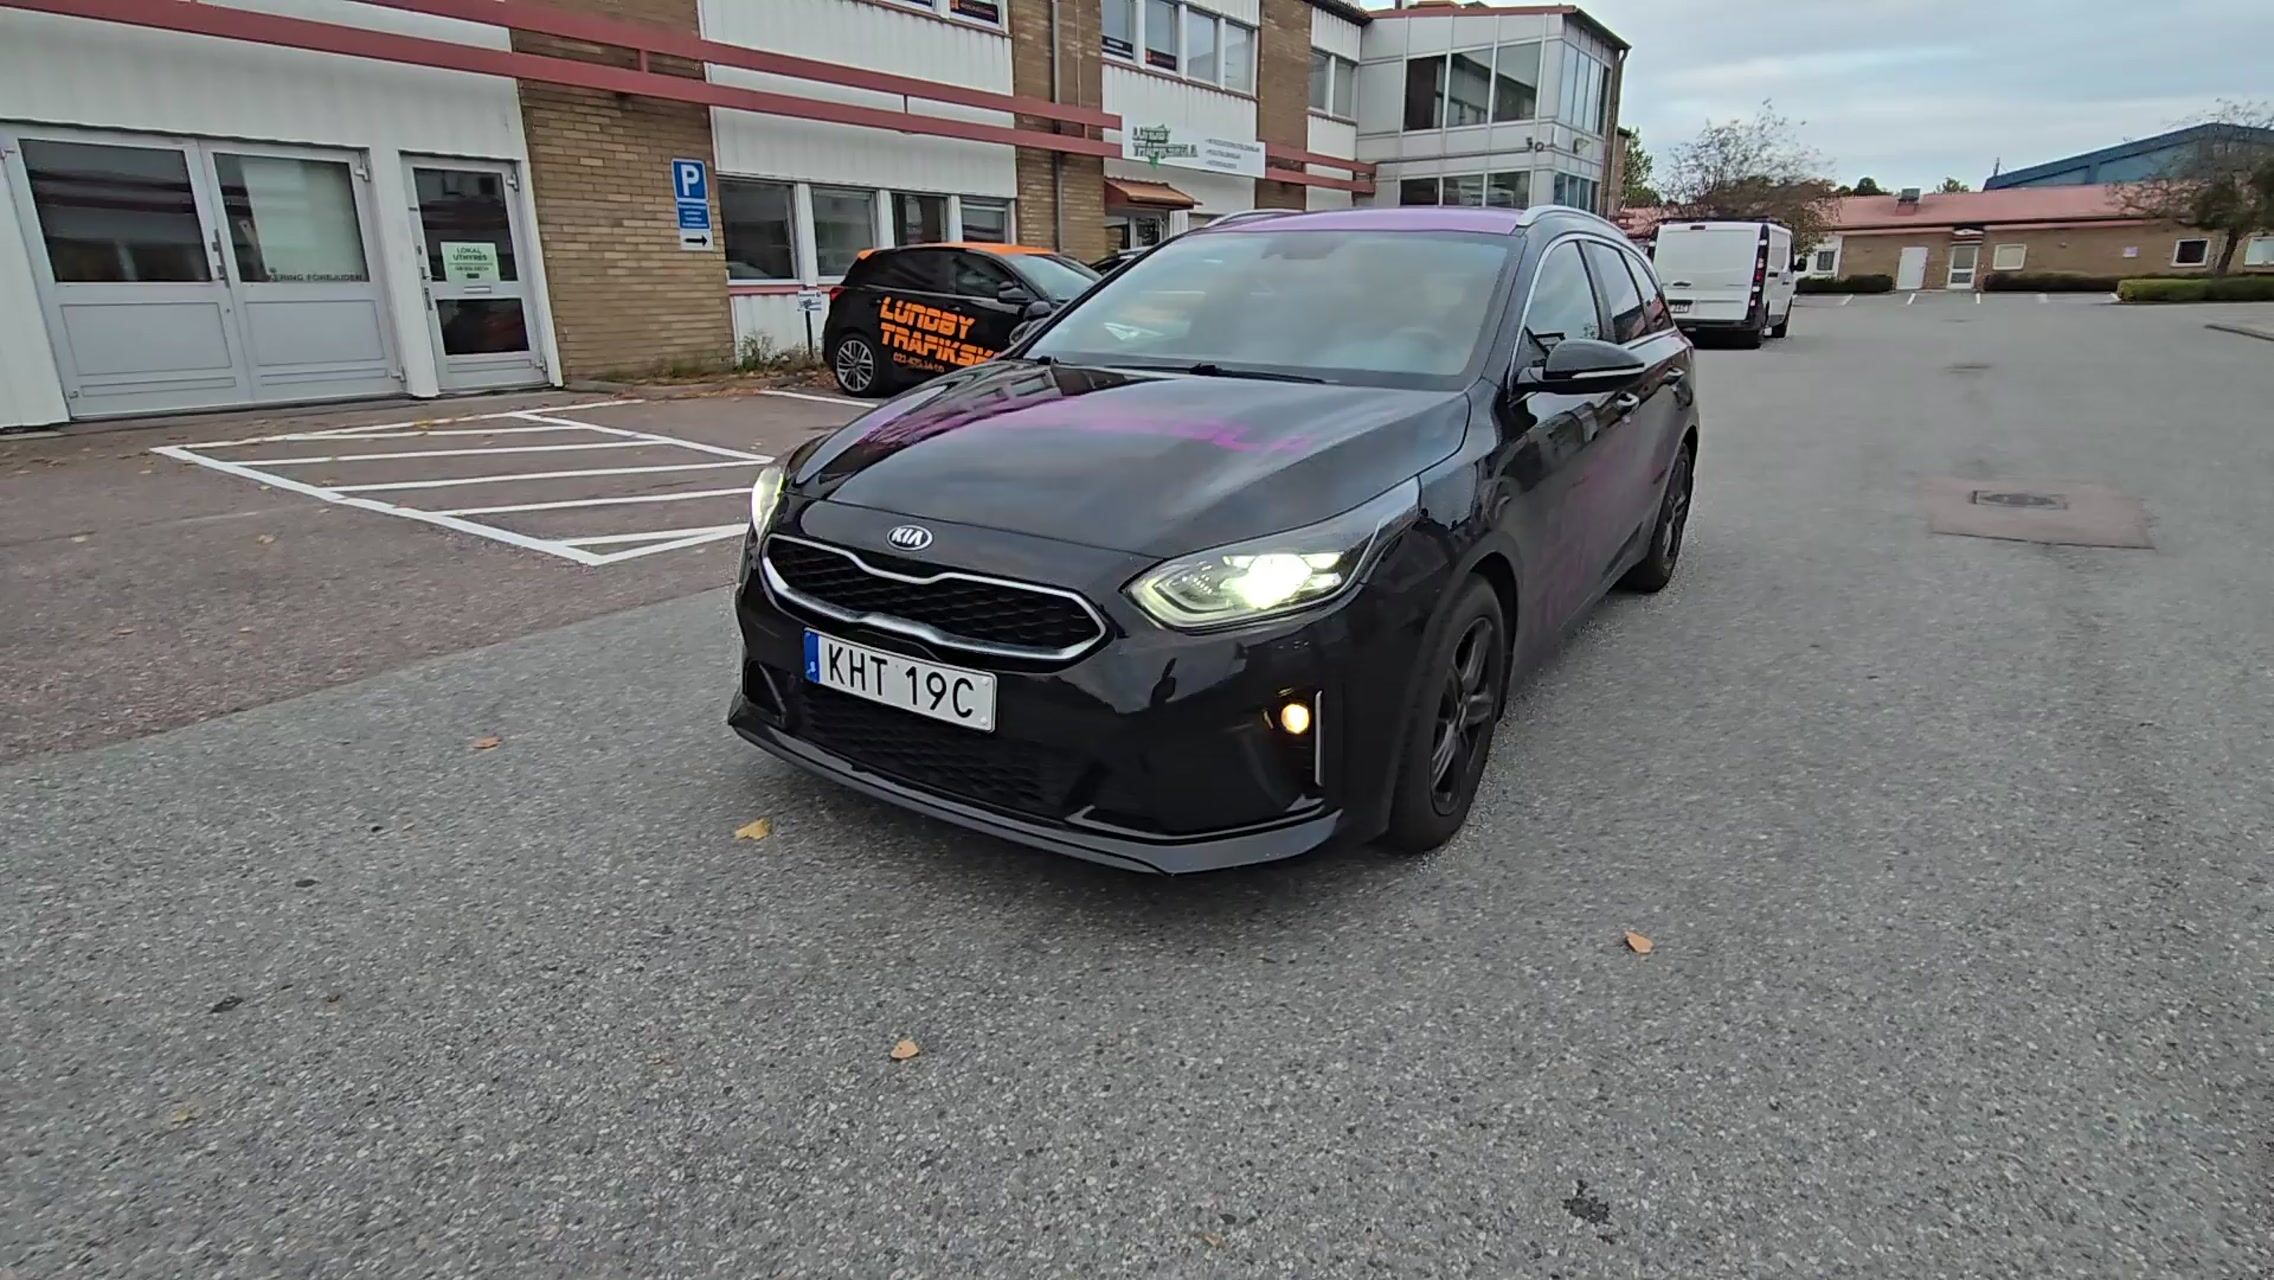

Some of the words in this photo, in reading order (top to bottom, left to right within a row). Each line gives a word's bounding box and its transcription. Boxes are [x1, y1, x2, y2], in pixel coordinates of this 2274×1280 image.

[681, 164, 700, 197] P
[880, 296, 976, 340] LUNDBY
[880, 322, 1000, 366] TRAFIKSK
[891, 527, 924, 546] KIA
[829, 643, 888, 696] KHT
[905, 666, 974, 718] 19C
